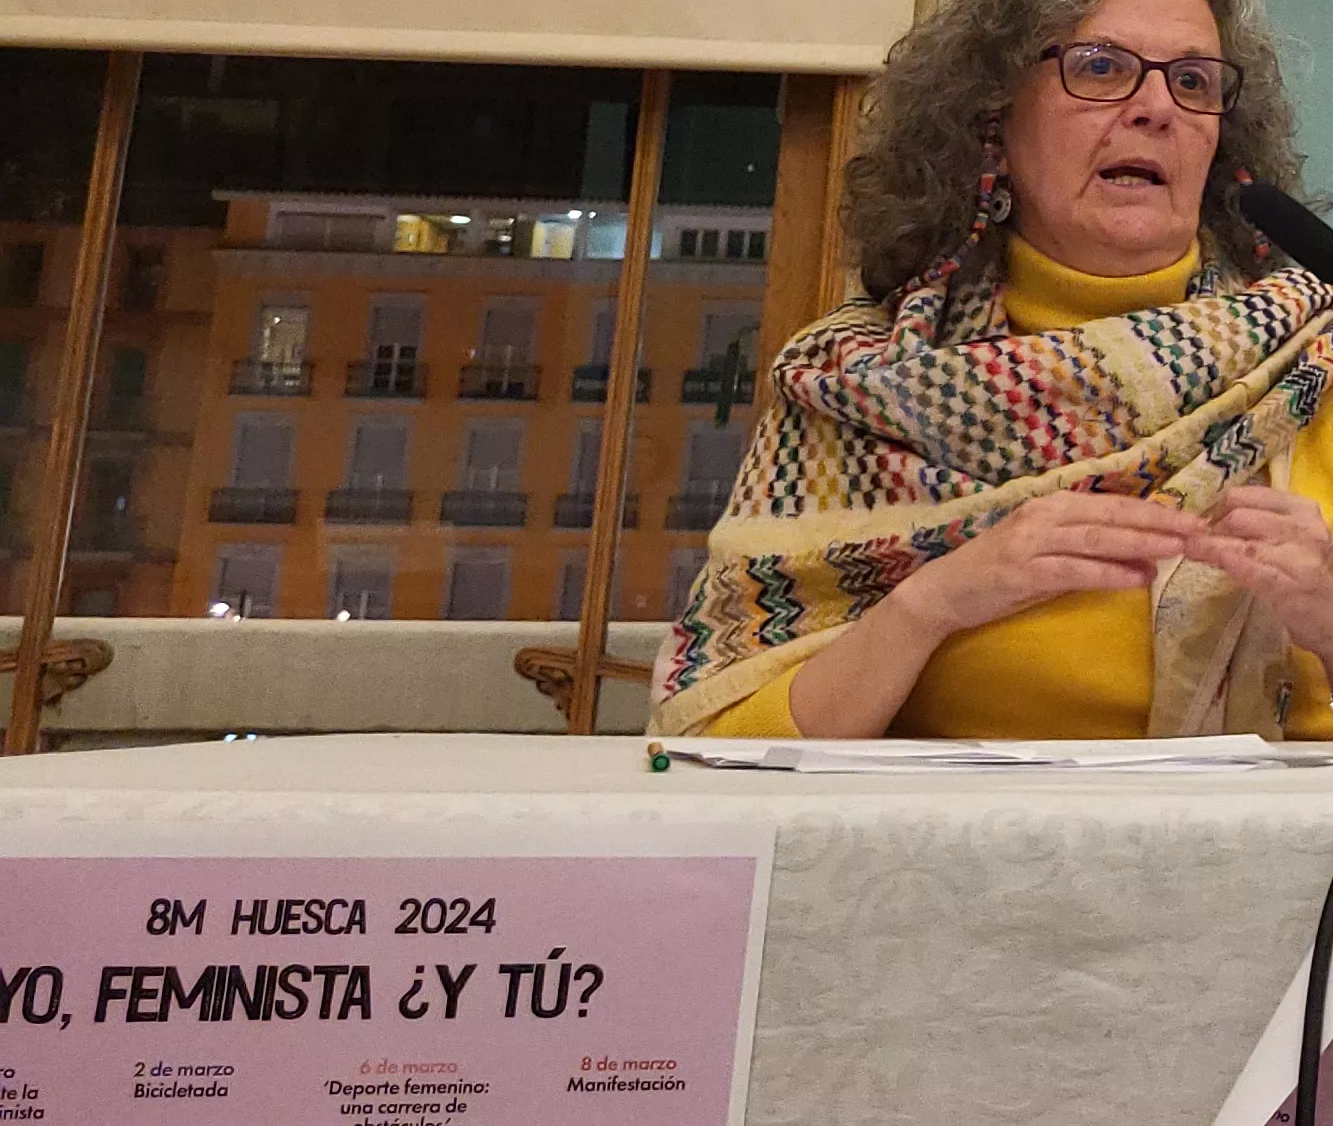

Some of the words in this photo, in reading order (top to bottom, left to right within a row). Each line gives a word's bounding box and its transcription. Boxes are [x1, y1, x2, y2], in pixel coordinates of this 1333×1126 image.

[146, 898, 206, 936] 8M
[231, 898, 367, 936] HUESCA
[395, 897, 497, 935] 2024
[94, 964, 373, 1023] FEMINISTA
[399, 963, 478, 1021] ¿Y
[498, 947, 605, 1019] TÚ?
[133, 1061, 146, 1077] 2
[150, 1060, 173, 1077] de
[177, 1064, 235, 1077] marzo
[359, 1058, 370, 1074] 6
[376, 1058, 398, 1074] de
[402, 1061, 457, 1074] marzo
[581, 1056, 592, 1071] 8
[597, 1056, 618, 1071] de
[622, 1058, 677, 1071] marzo
[22, 1084, 39, 1100] la
[133, 1081, 229, 1098] Bicicletada
[404, 1077, 490, 1095] femenino:
[566, 1075, 686, 1093] Manifestación
[340, 1102, 374, 1115] una
[378, 1101, 440, 1115] carrera
[445, 1097, 467, 1114] de
